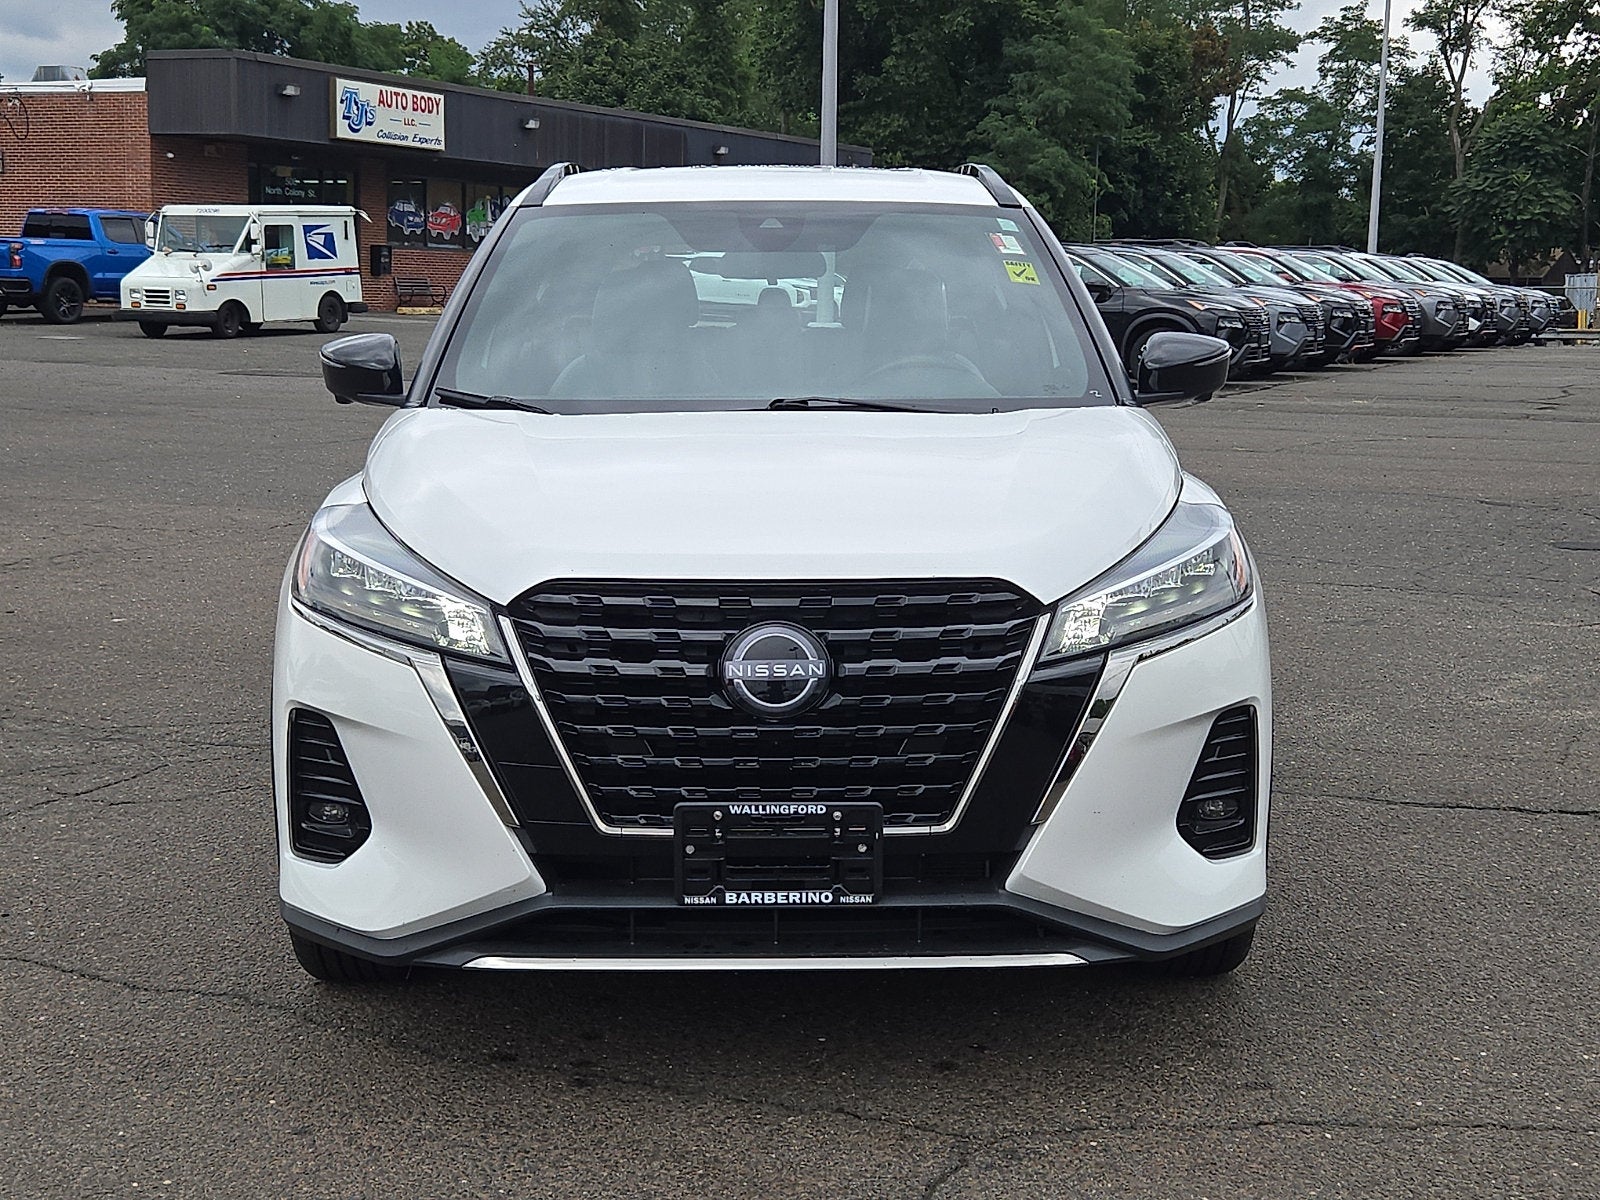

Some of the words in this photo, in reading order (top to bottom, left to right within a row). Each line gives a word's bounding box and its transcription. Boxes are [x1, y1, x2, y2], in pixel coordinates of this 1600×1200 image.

[377, 89, 408, 111] AUTO
[412, 94, 441, 116] BODY
[376, 129, 409, 142] Collision
[412, 133, 442, 146] Experts
[728, 663, 823, 677] NISSAN
[729, 804, 827, 815] WALLINGFORD
[684, 896, 717, 904] NISSAN
[725, 892, 833, 904] BARBERINO
[840, 895, 873, 904] NISSAN
